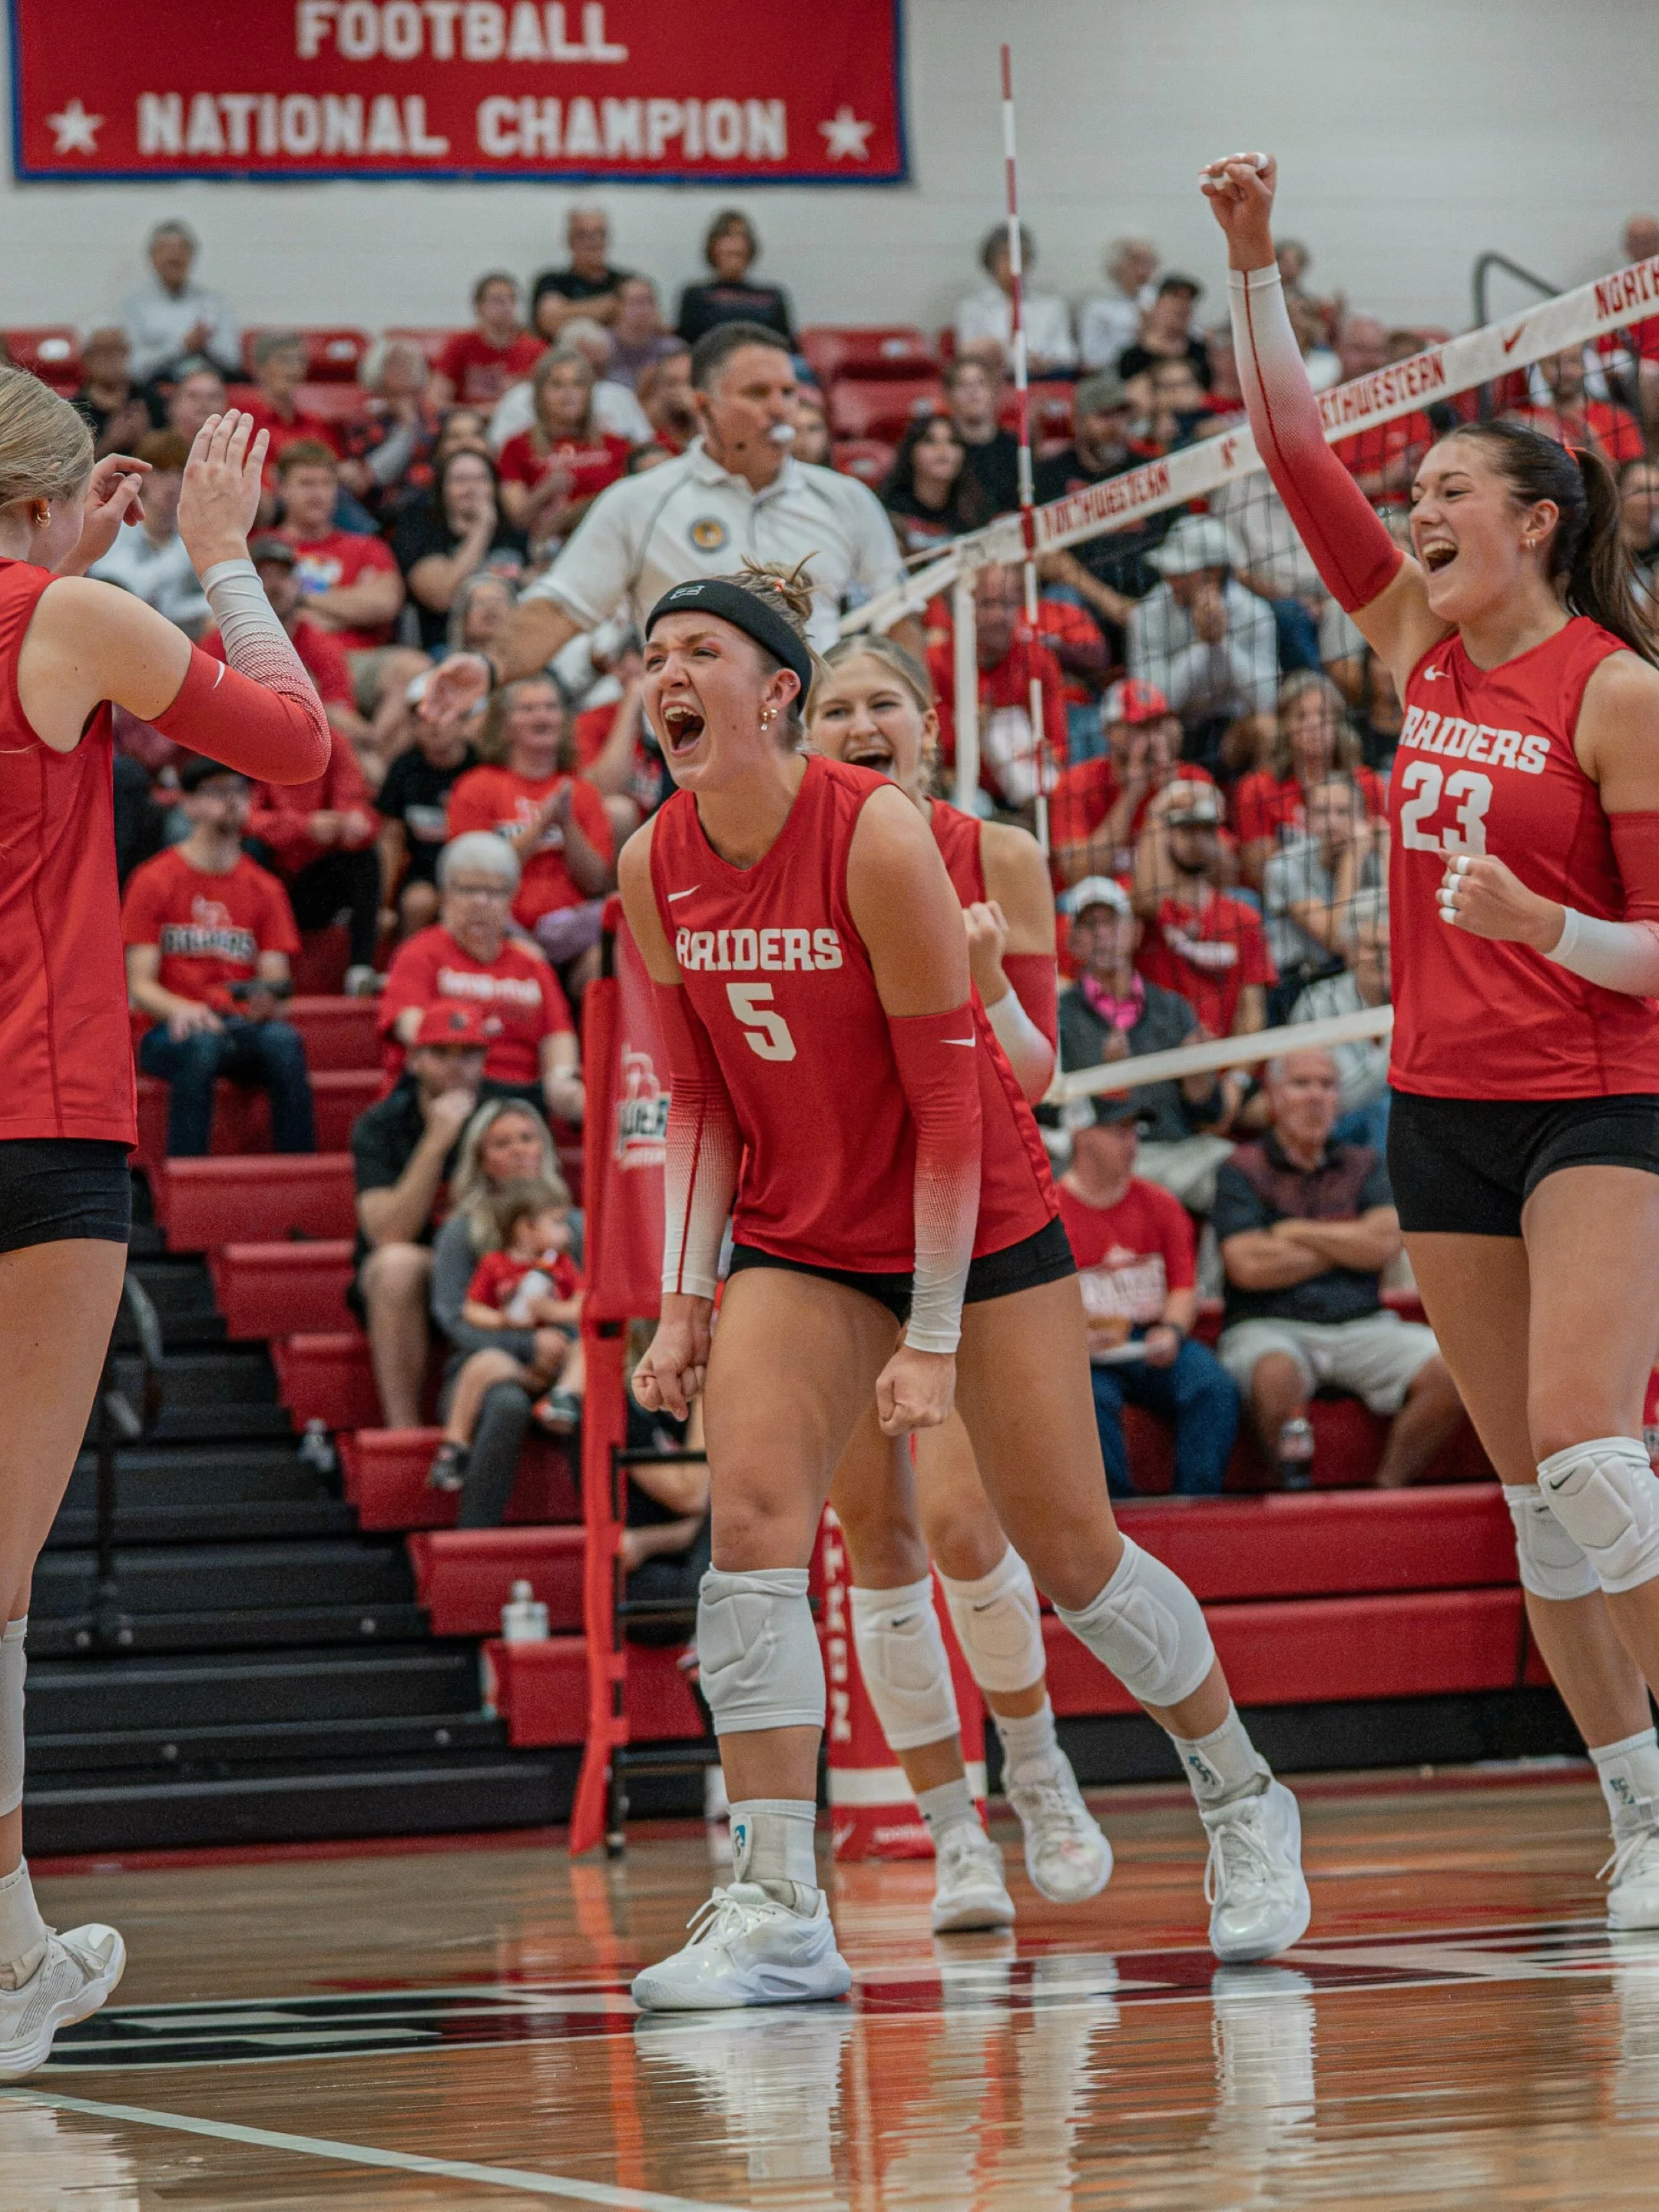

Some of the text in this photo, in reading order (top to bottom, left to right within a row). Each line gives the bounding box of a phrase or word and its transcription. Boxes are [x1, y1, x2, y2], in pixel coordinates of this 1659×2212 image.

[296, 0, 629, 61] FOOTBALL
[137, 91, 789, 161] NATIONAL CHAMPION
[1399, 704, 1551, 775] RAIDERS
[1400, 760, 1494, 856] 23
[675, 926, 843, 971] RAIDERS
[726, 982, 796, 1062] 5
